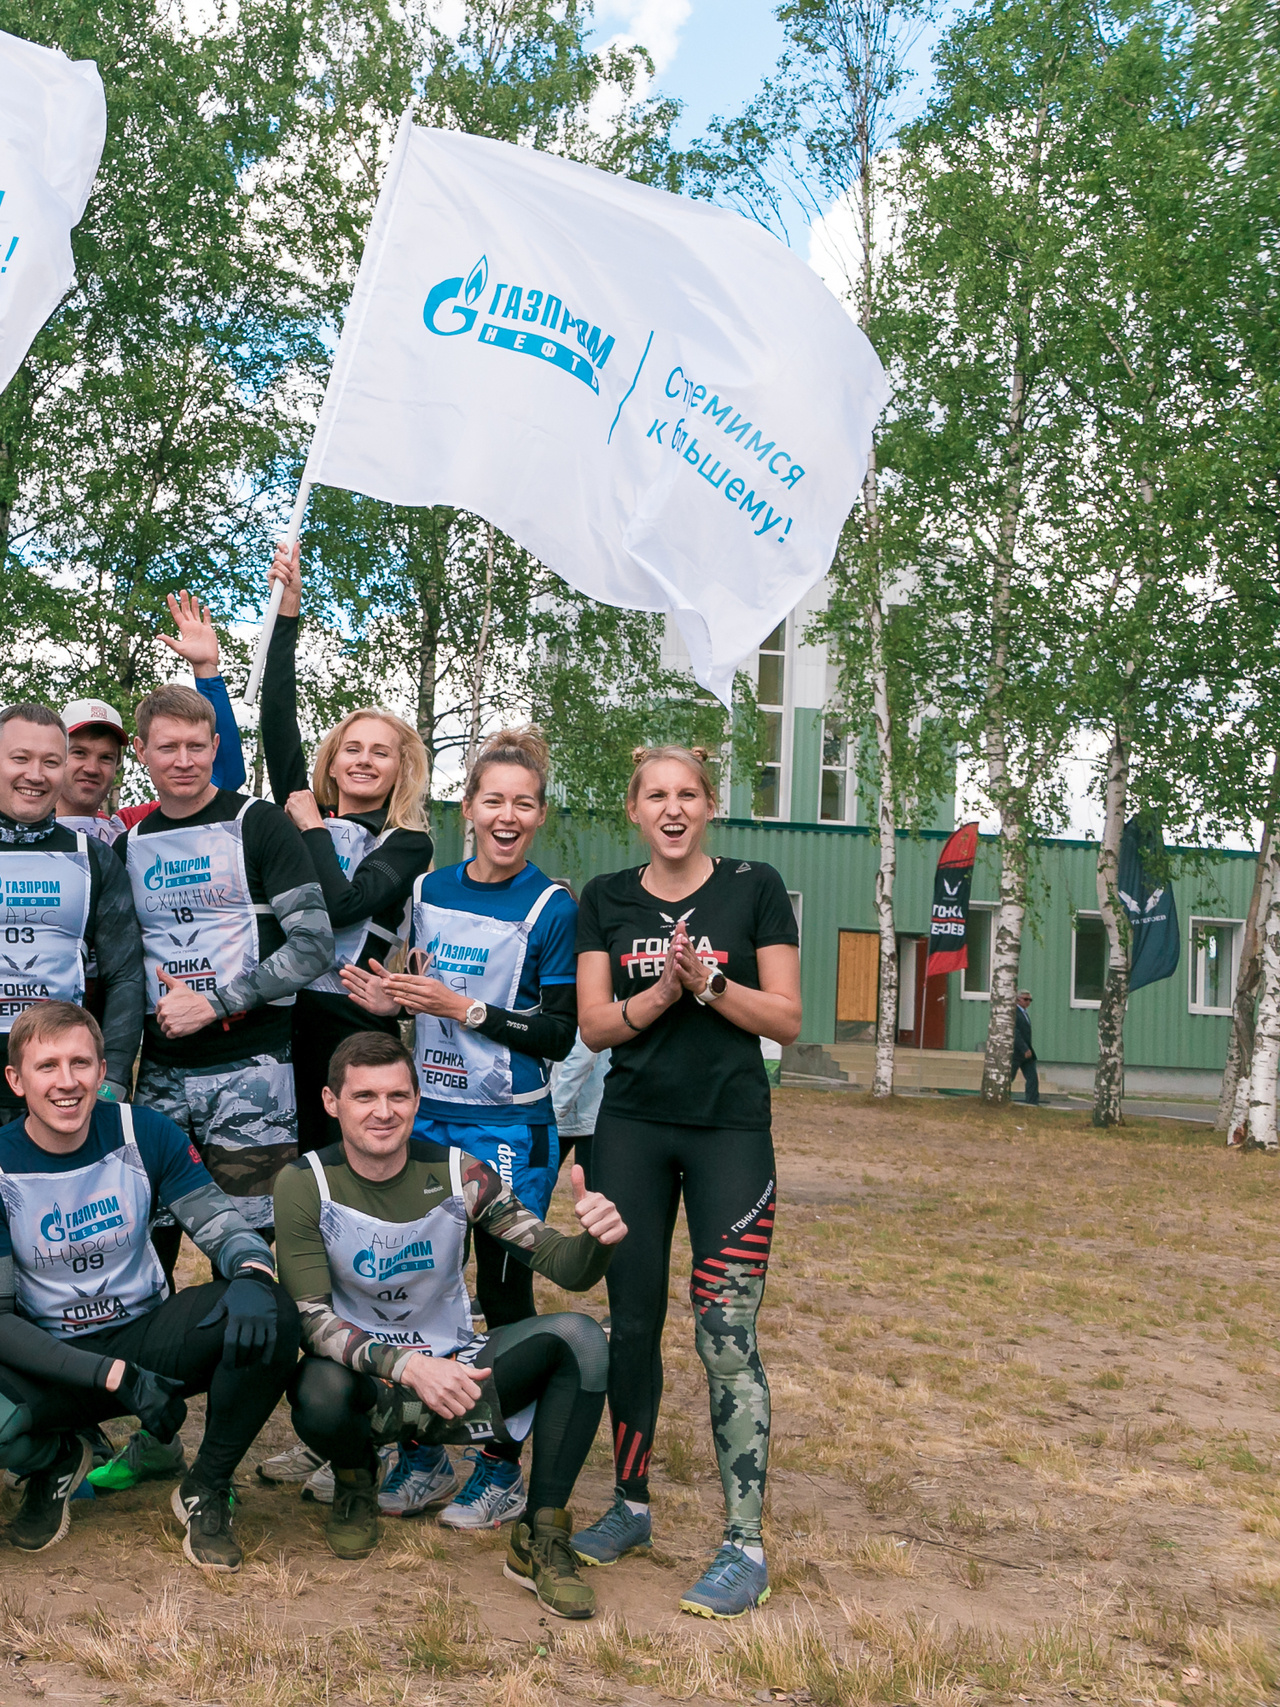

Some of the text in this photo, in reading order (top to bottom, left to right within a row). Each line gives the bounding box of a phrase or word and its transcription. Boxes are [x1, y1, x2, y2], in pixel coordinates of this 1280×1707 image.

[488, 283, 616, 369] ГАЗПРОМ
[483, 326, 598, 389] НЕФТЬ
[164, 855, 210, 876] ГАЗПРОМ
[6, 881, 60, 894] ГАЗПРОМ
[166, 873, 211, 887] НЕФТЬ
[7, 897, 59, 906] НЕФТЬ
[171, 907, 195, 924] 18
[5, 927, 35, 943] 03
[930, 922, 965, 936] ЕРОЕВ
[440, 943, 489, 963] ГАЗПРОМ
[424, 1049, 465, 1068] ГОНКА
[423, 1185, 444, 1195] Reebok
[66, 1195, 120, 1228] ГАЗПРОМ
[730, 1208, 760, 1233] ГОНКА
[70, 1216, 122, 1240] НЕФТЬ
[72, 1253, 104, 1274] 09
[63, 1296, 125, 1319] ГОНКА
